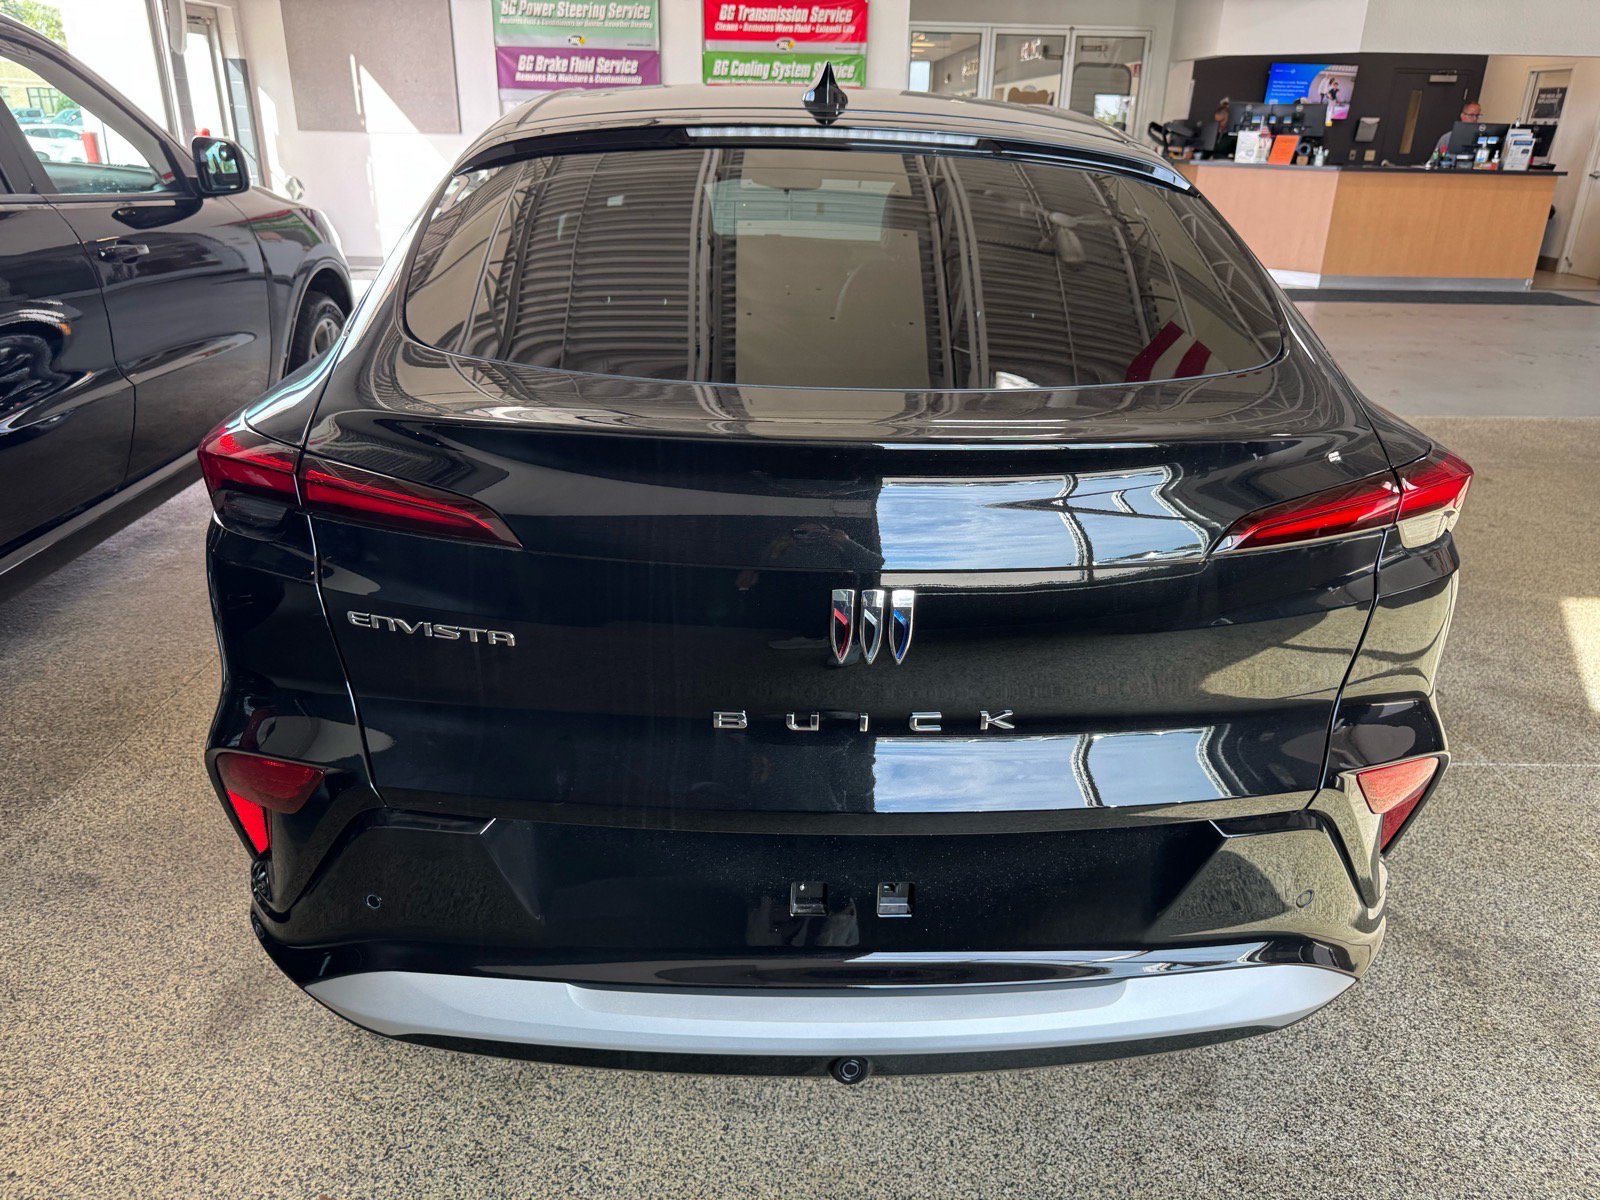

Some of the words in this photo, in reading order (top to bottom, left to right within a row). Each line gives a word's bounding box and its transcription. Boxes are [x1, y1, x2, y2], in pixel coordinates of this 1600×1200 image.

[501, 0, 518, 16] BG
[518, 0, 555, 17] Power
[557, 1, 607, 21] Steering
[608, 3, 651, 20] Service
[719, 4, 735, 21] BG
[738, 5, 809, 23] Transmission
[810, 6, 853, 23] Service
[518, 55, 535, 72] BG
[535, 55, 568, 73] Brake
[569, 56, 595, 74] Fluid
[595, 57, 638, 74] Service
[713, 59, 729, 76] BG
[730, 60, 770, 80] Cooling
[771, 61, 811, 80] System
[813, 62, 856, 79] Svice
[515, 72, 546, 82] Removes
[594, 74, 642, 85] Contaminants
[347, 610, 516, 647] ENVISTA
[712, 709, 1016, 733] BUICK
